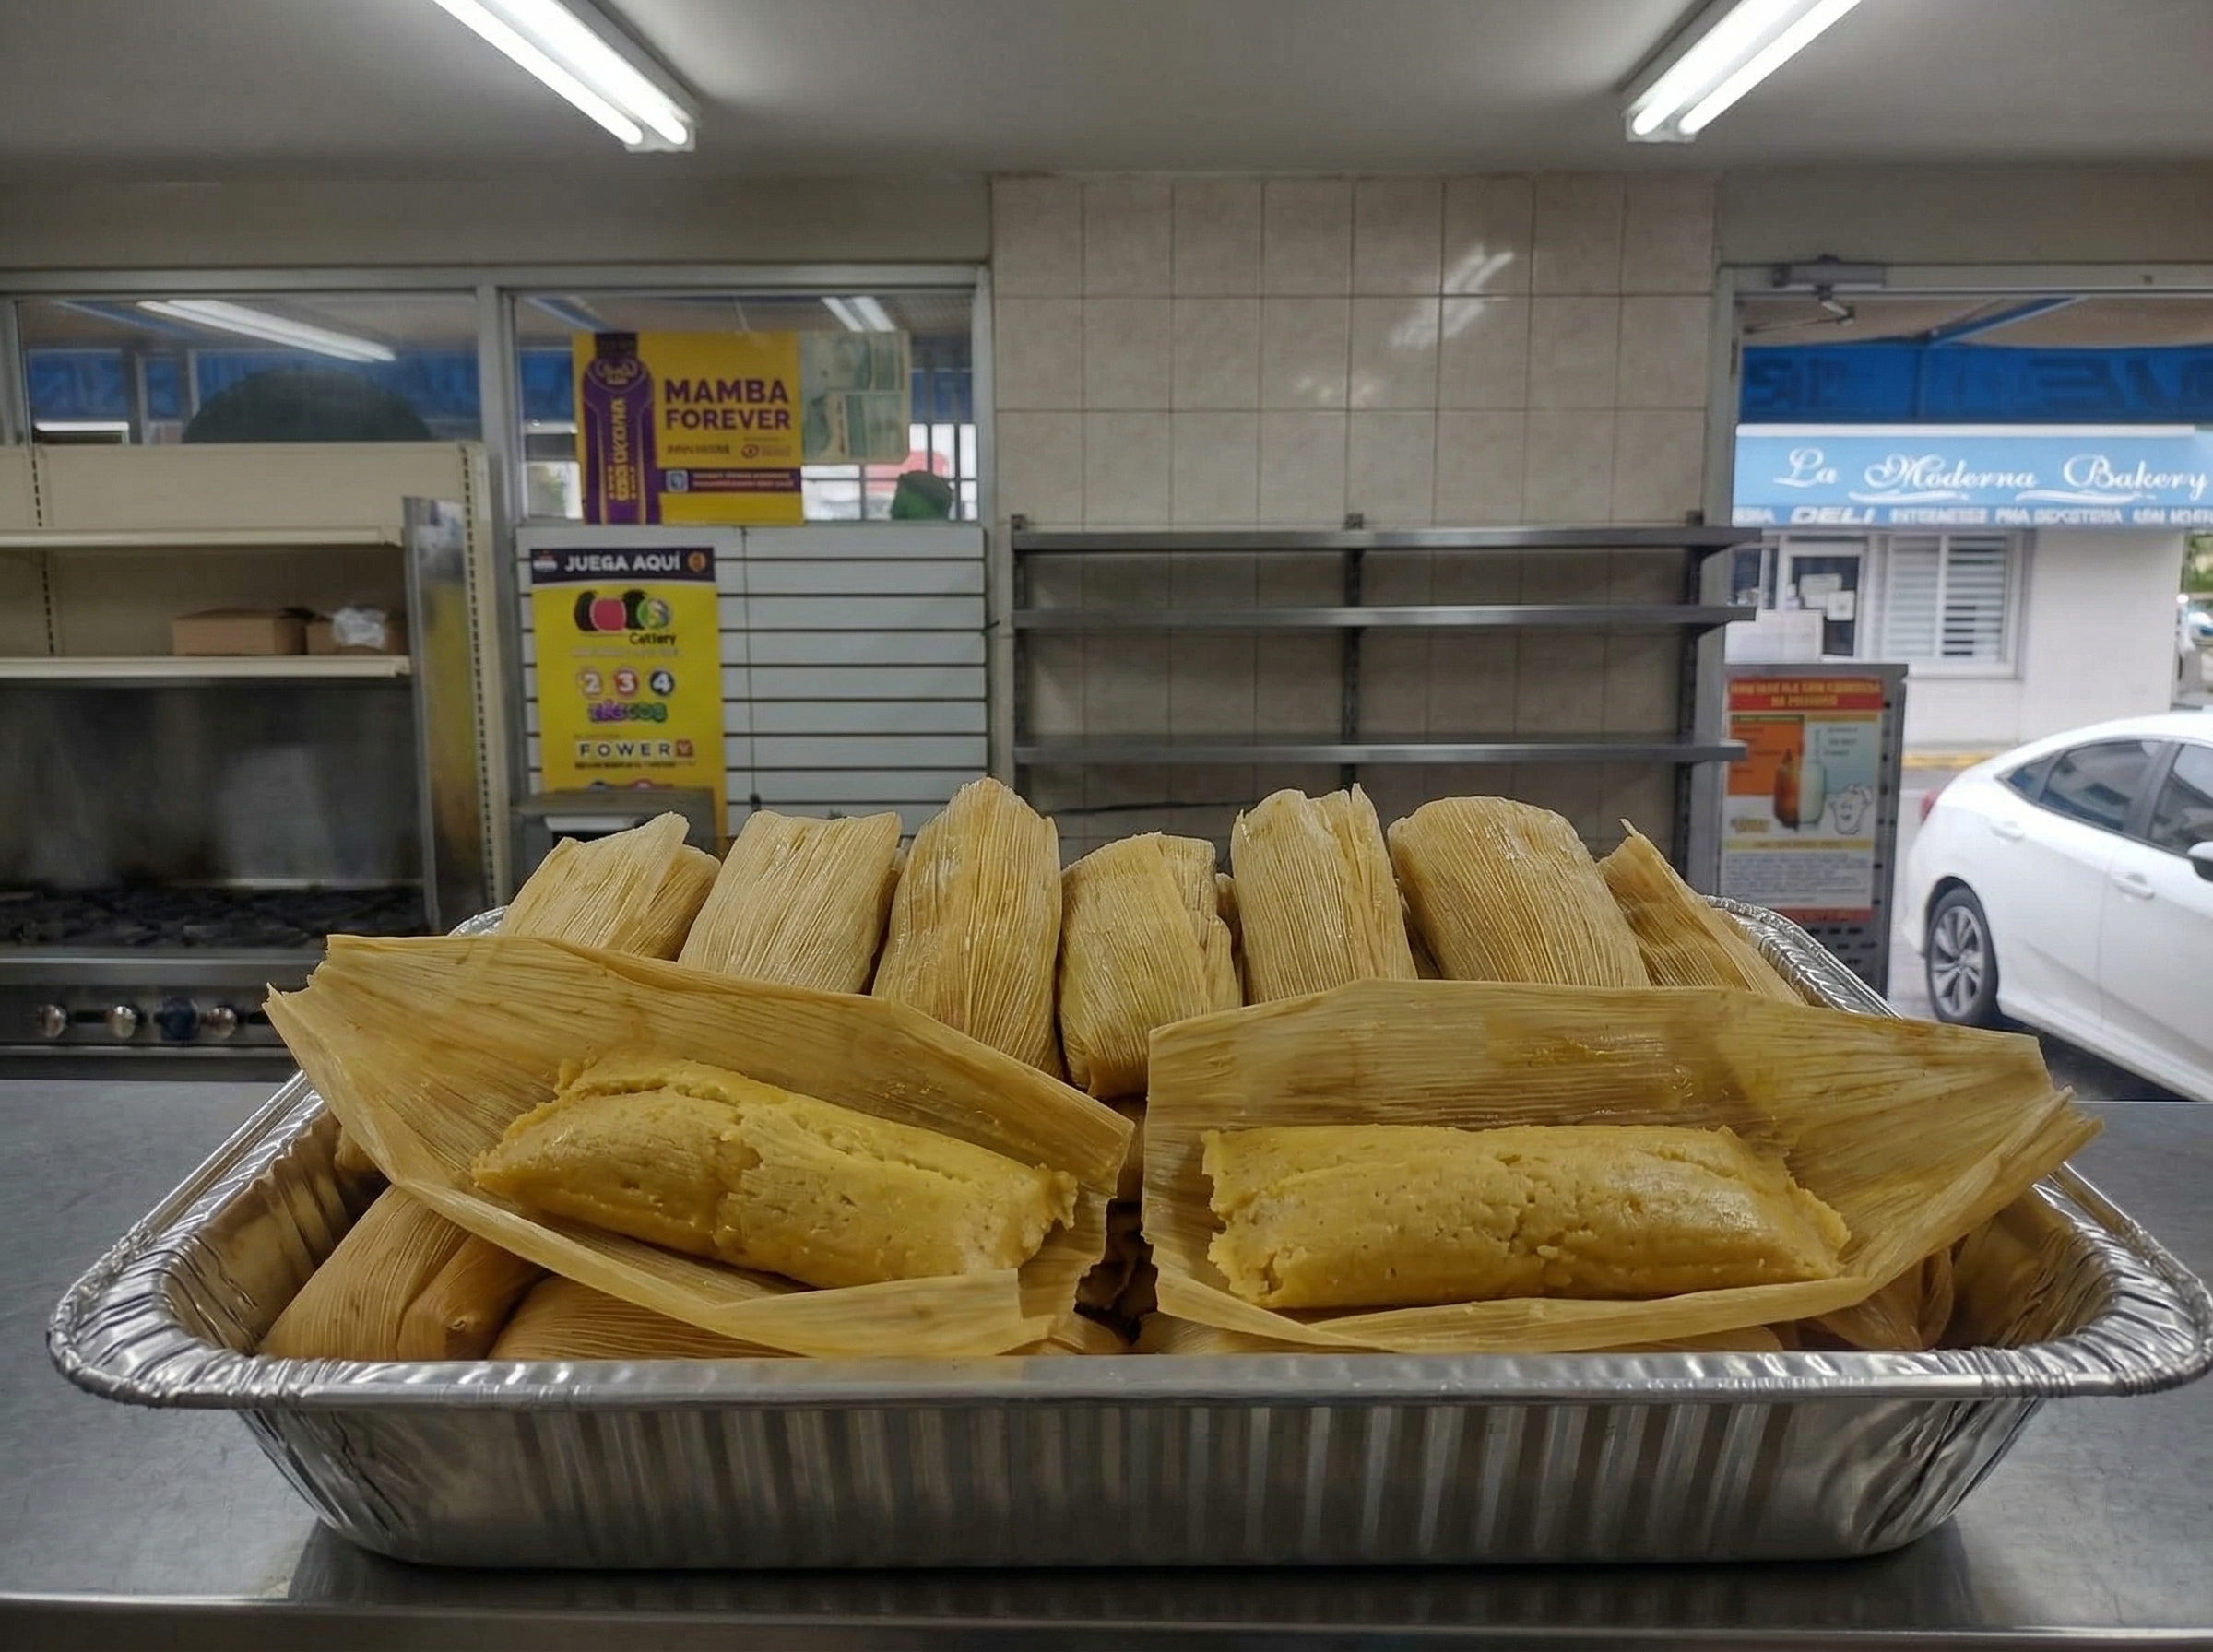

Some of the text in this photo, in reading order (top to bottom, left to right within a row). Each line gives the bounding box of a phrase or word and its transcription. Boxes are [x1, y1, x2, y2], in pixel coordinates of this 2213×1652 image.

[664, 379, 789, 404] MAMBA
[666, 409, 791, 431] FOREVER
[1772, 446, 2209, 504] La Moderna Bakery
[1790, 506, 1876, 525] DELI
[564, 551, 681, 572] JUEGA AQUÍ
[652, 674, 671, 693] 4
